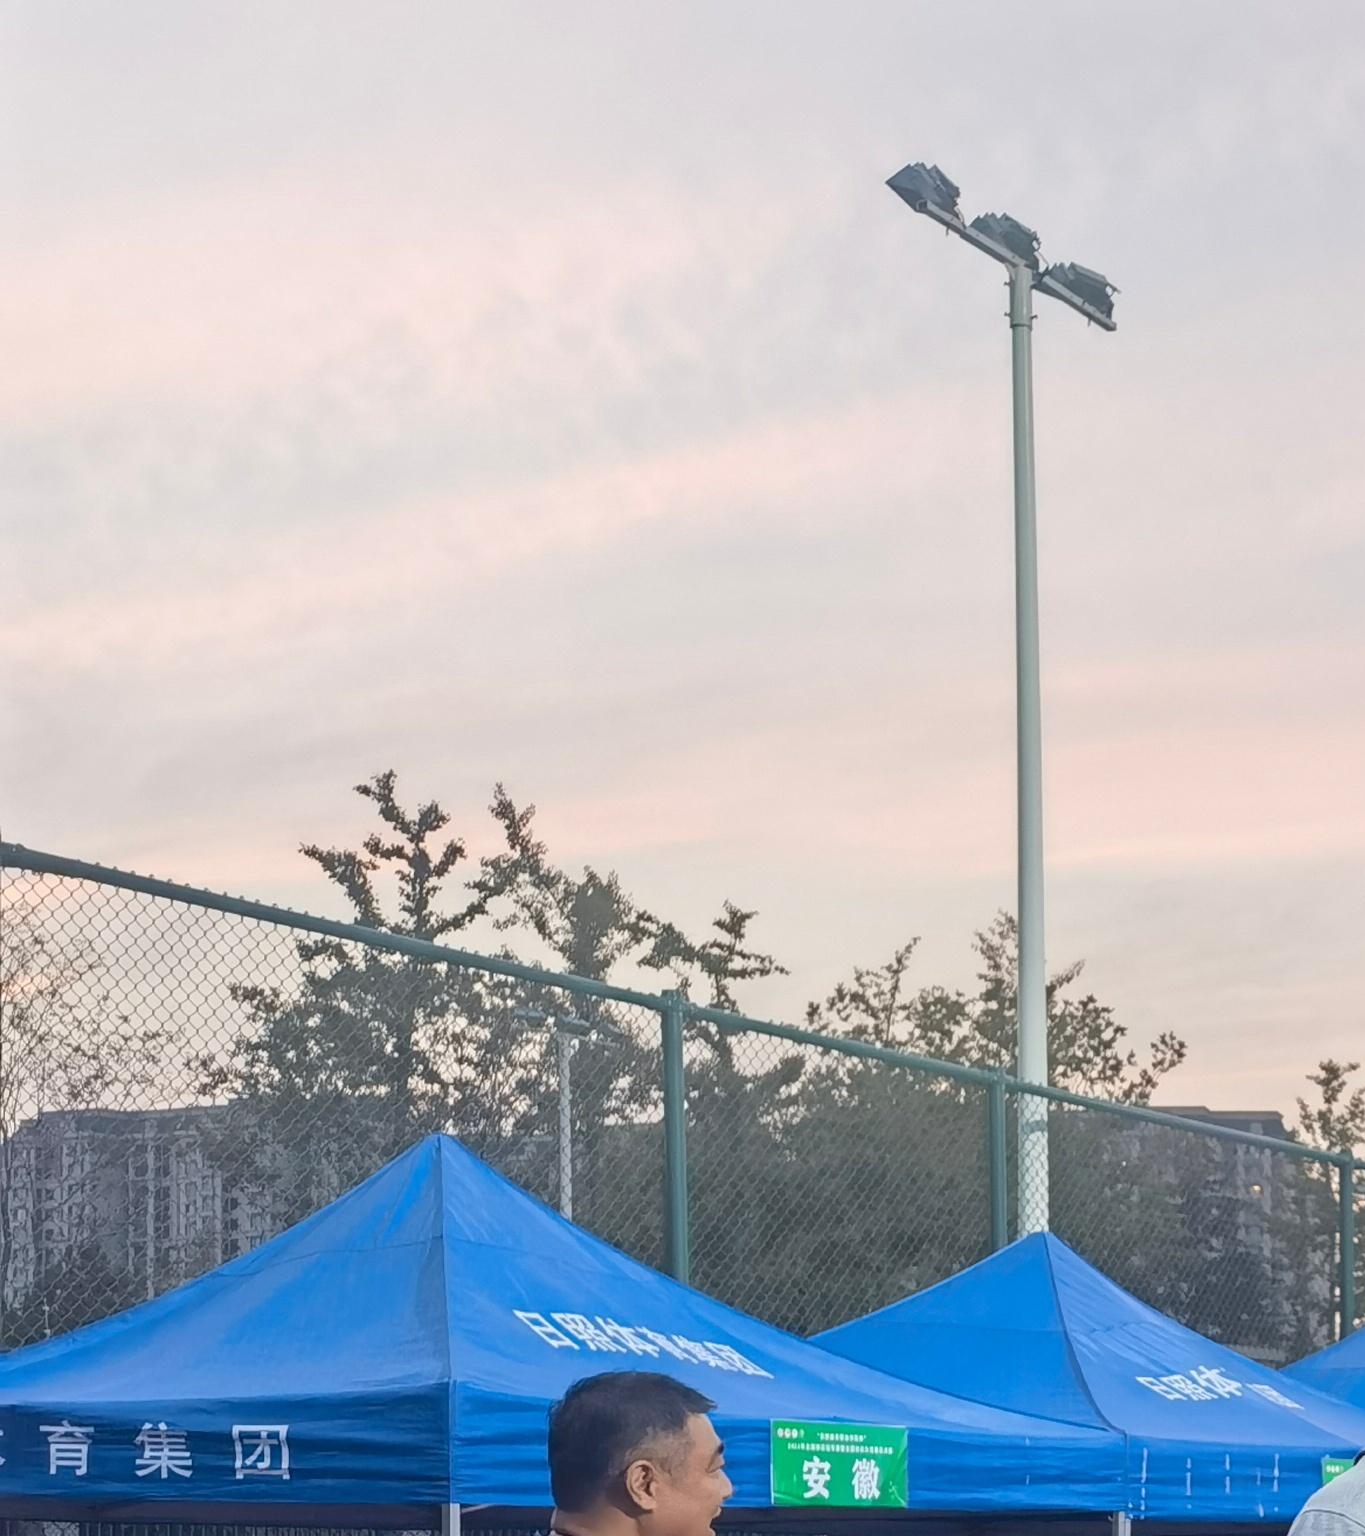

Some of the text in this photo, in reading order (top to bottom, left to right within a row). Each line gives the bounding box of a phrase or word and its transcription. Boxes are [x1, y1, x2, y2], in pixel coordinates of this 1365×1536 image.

[0, 1420, 291, 1480] 育集团
[802, 1455, 881, 1500] 安徽
